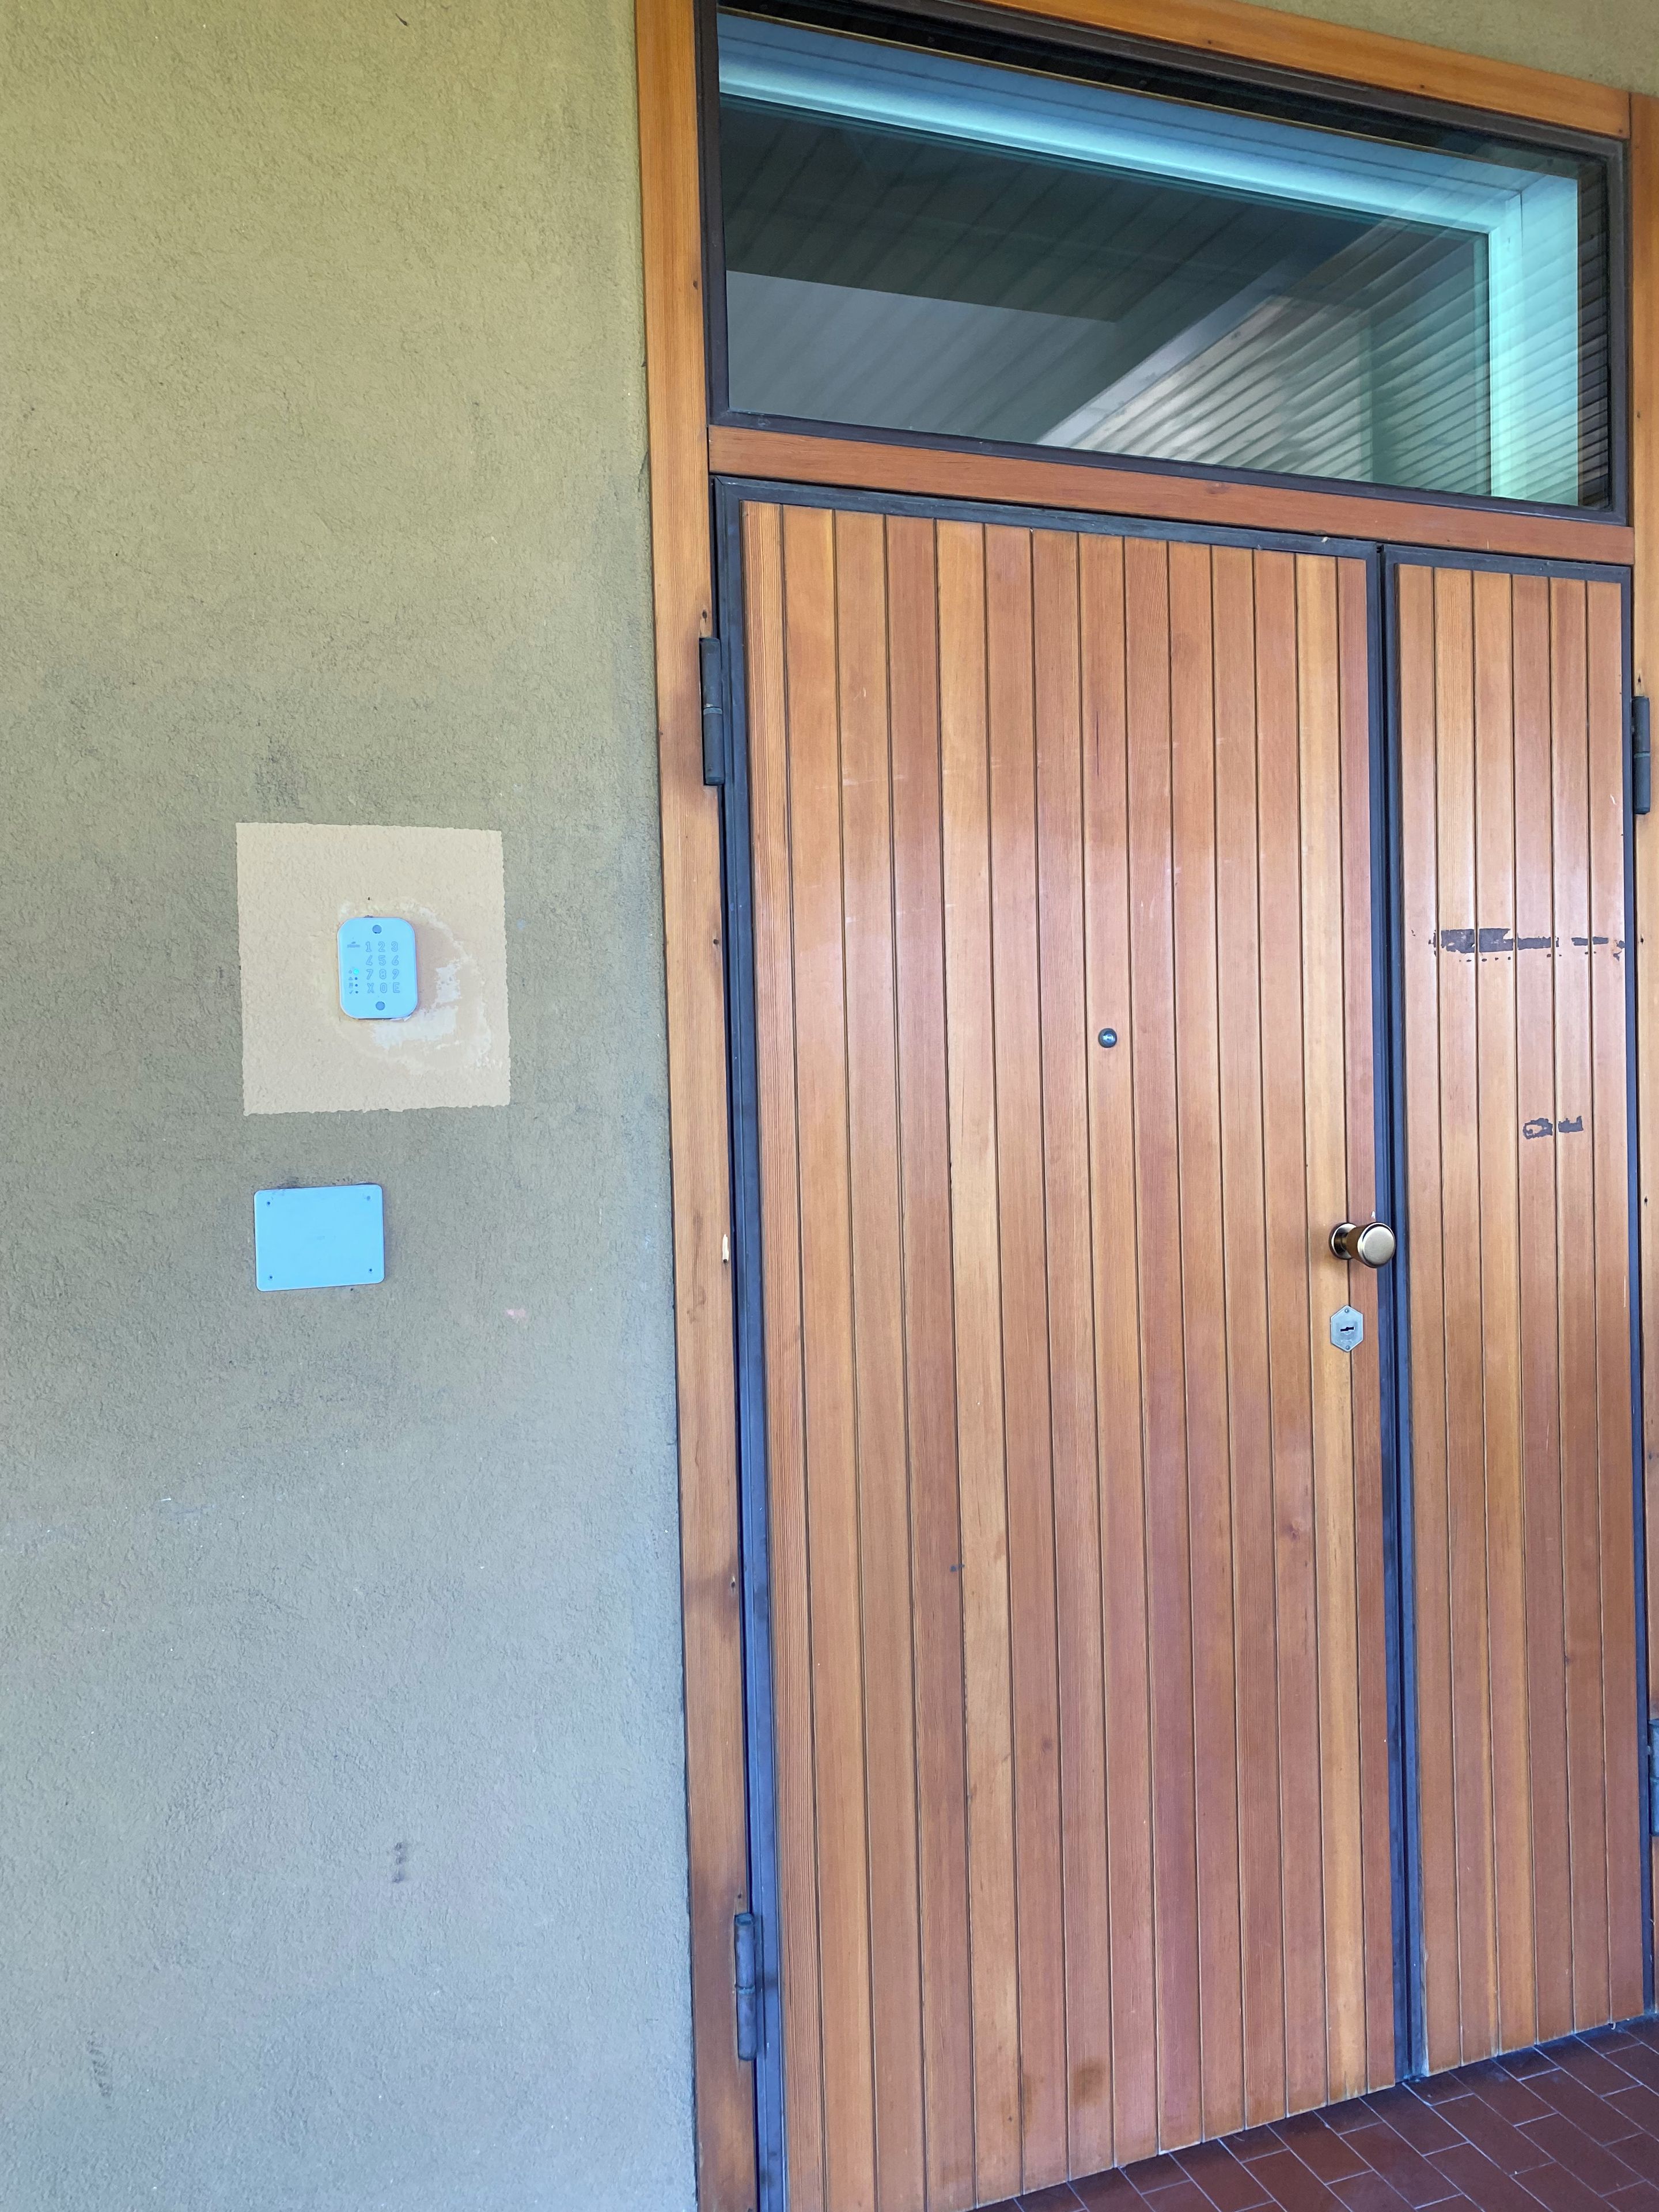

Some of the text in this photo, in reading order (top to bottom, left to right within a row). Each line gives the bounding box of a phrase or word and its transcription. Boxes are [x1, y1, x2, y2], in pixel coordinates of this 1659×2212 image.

[365, 941, 398, 952] 1 2 3
[378, 955, 386, 965] 5
[392, 955, 399, 965] 6
[366, 969, 399, 980] 7 8 9
[367, 983, 374, 993] X
[393, 982, 400, 993] E
